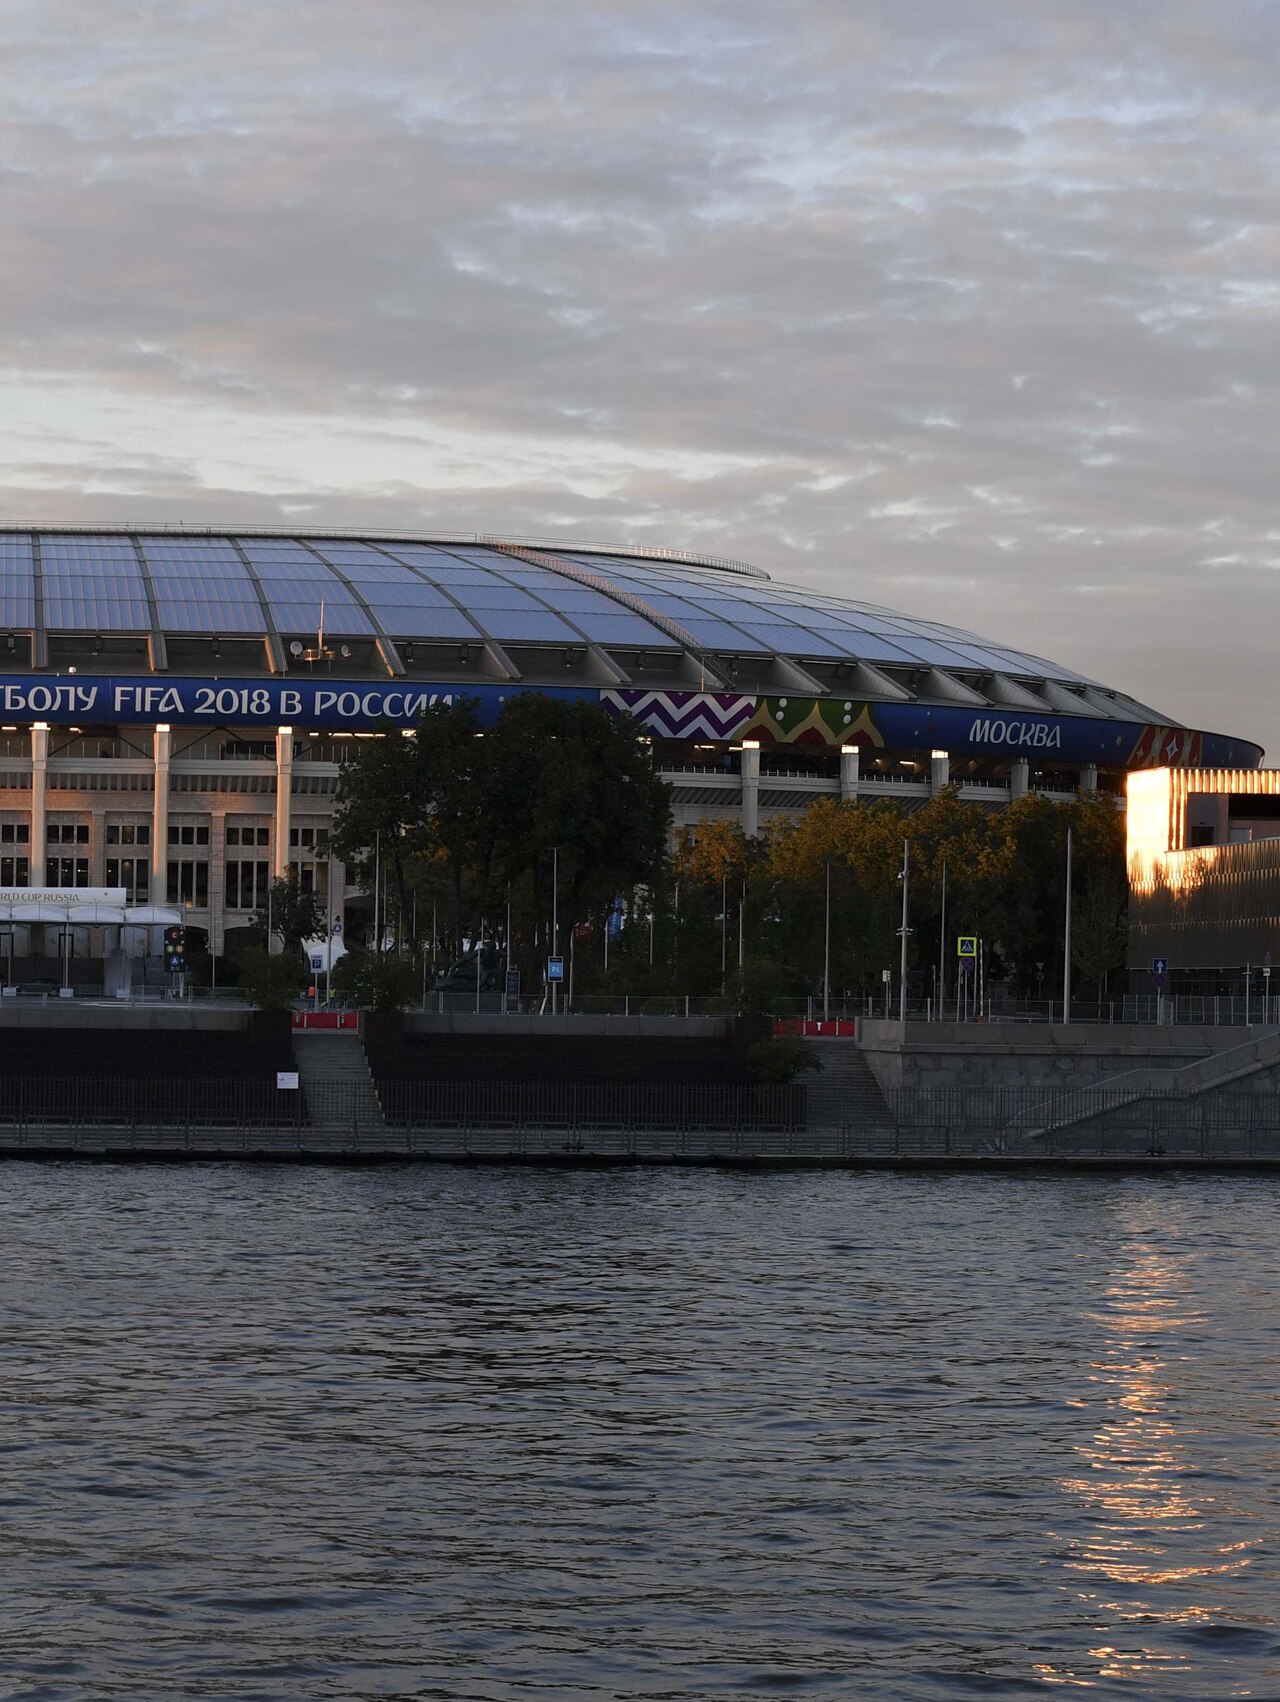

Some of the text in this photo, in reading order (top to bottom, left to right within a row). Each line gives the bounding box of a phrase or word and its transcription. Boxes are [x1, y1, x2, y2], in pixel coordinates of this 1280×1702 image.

[114, 686, 185, 713] FIFA
[194, 688, 271, 715] 2018
[280, 690, 302, 715] В
[969, 719, 1061, 748] МОСКВА
[21, 893, 42, 902] CUP
[43, 893, 80, 902] RUSSIA
